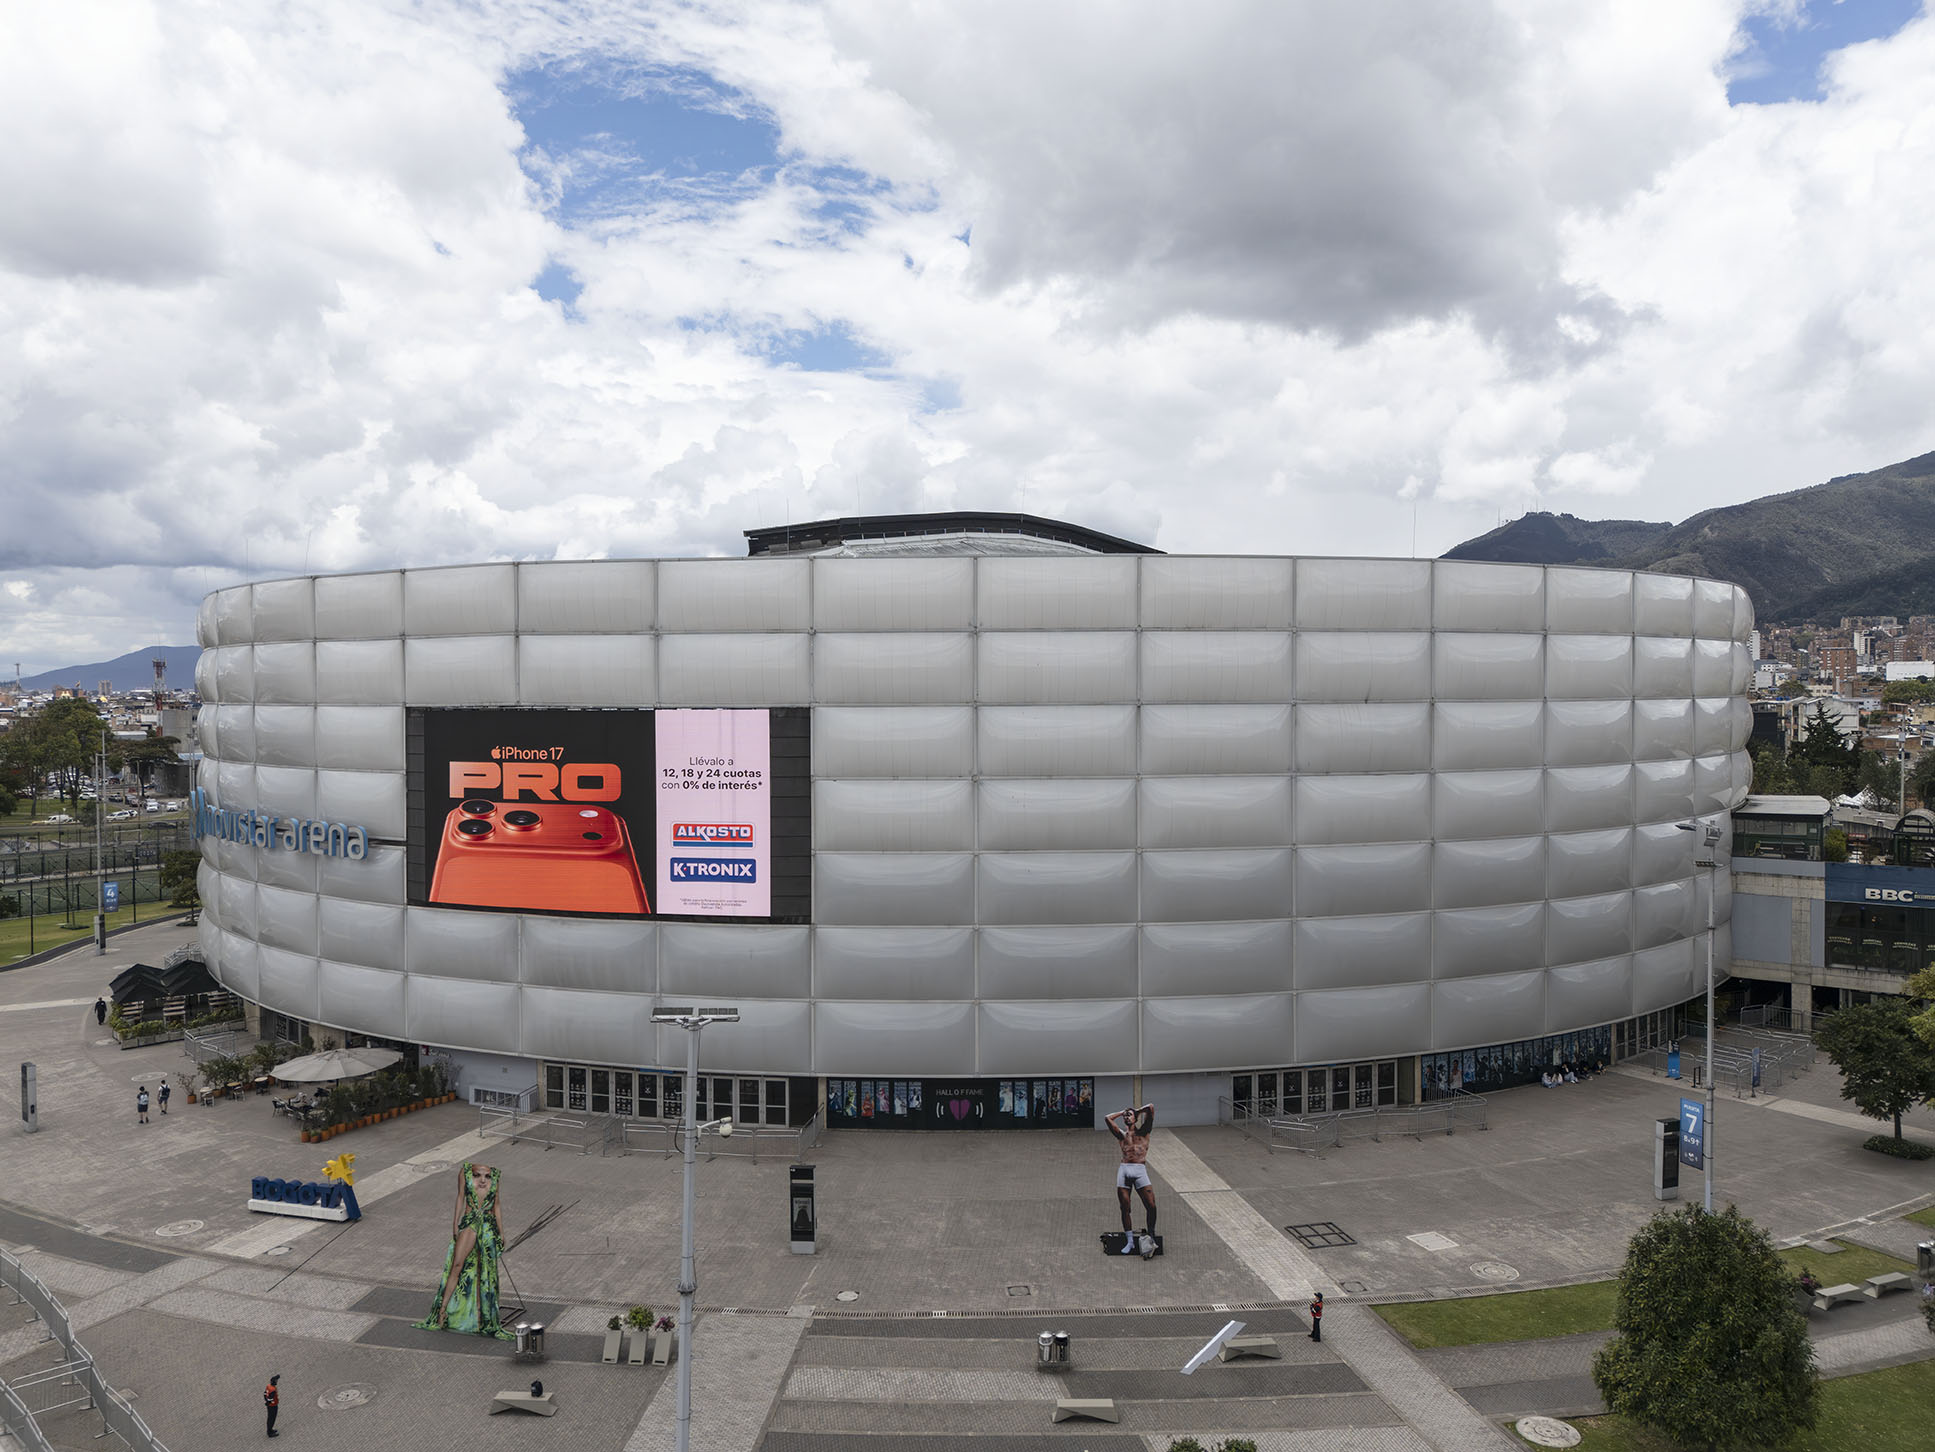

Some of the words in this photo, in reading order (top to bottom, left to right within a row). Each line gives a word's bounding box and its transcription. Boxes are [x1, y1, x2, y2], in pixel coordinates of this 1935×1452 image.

[502, 747, 548, 760] iPhone
[549, 747, 564, 760] 17
[689, 756, 725, 766] Llévalo
[727, 758, 734, 766] a
[449, 761, 622, 802] PRO
[663, 769, 679, 779] 12,
[681, 769, 694, 778] 18
[697, 770, 704, 779] y
[706, 769, 720, 778] 24
[723, 769, 762, 778] cuotas
[682, 780, 700, 789] 0%
[702, 781, 716, 789] de
[282, 817, 369, 861] arena
[676, 825, 751, 842] ALKOSTO
[1864, 887, 1914, 903] BBC
[1686, 1113, 1697, 1134] 7
